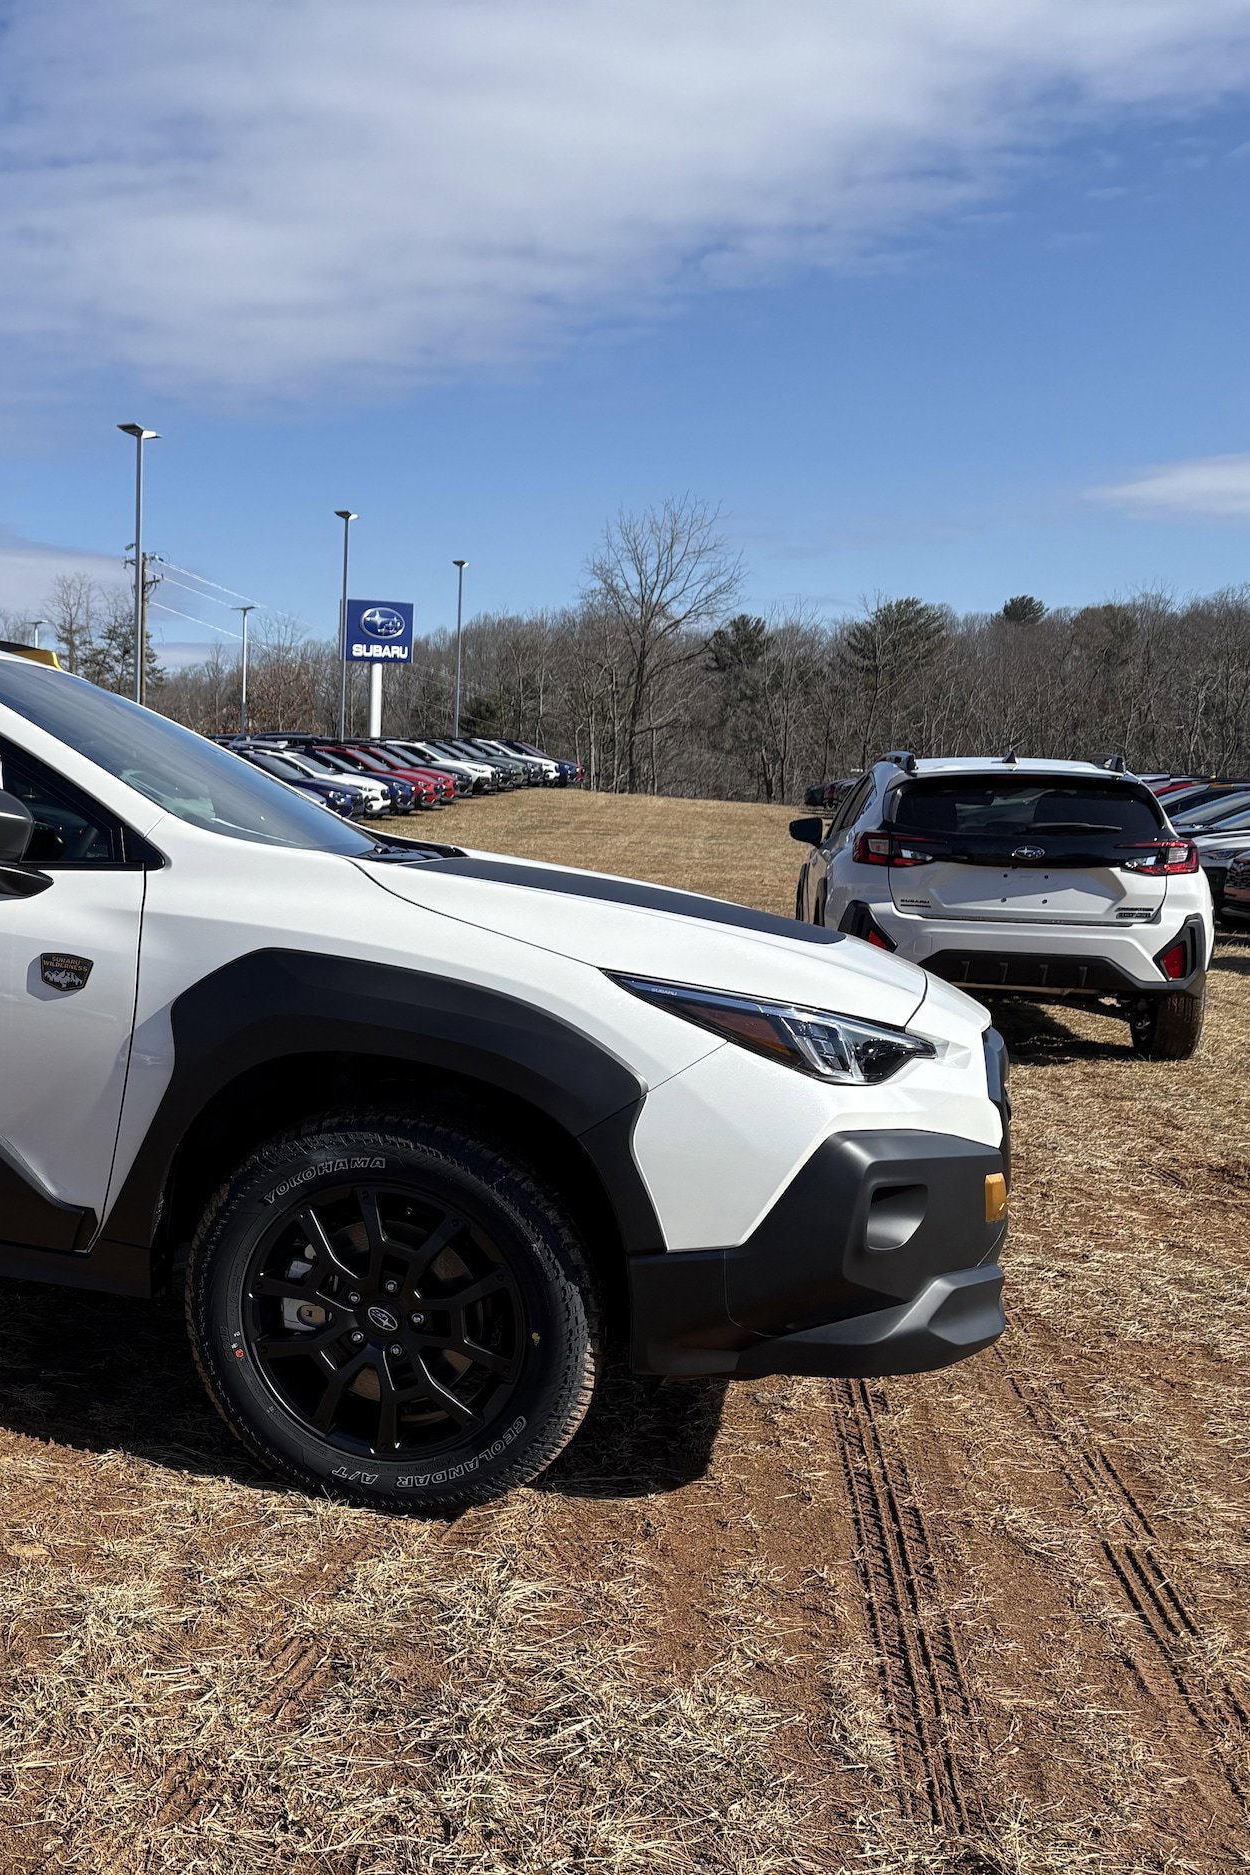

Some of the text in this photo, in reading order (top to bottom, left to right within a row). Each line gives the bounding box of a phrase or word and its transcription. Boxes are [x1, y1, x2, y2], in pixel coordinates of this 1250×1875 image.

[352, 643, 409, 659] SUBARU
[43, 959, 88, 972] WILDERNESS
[52, 956, 81, 966] SUBARU
[264, 1157, 386, 1204] YOKOHAMA
[332, 1415, 527, 1488] GEOLANDAR A/T
